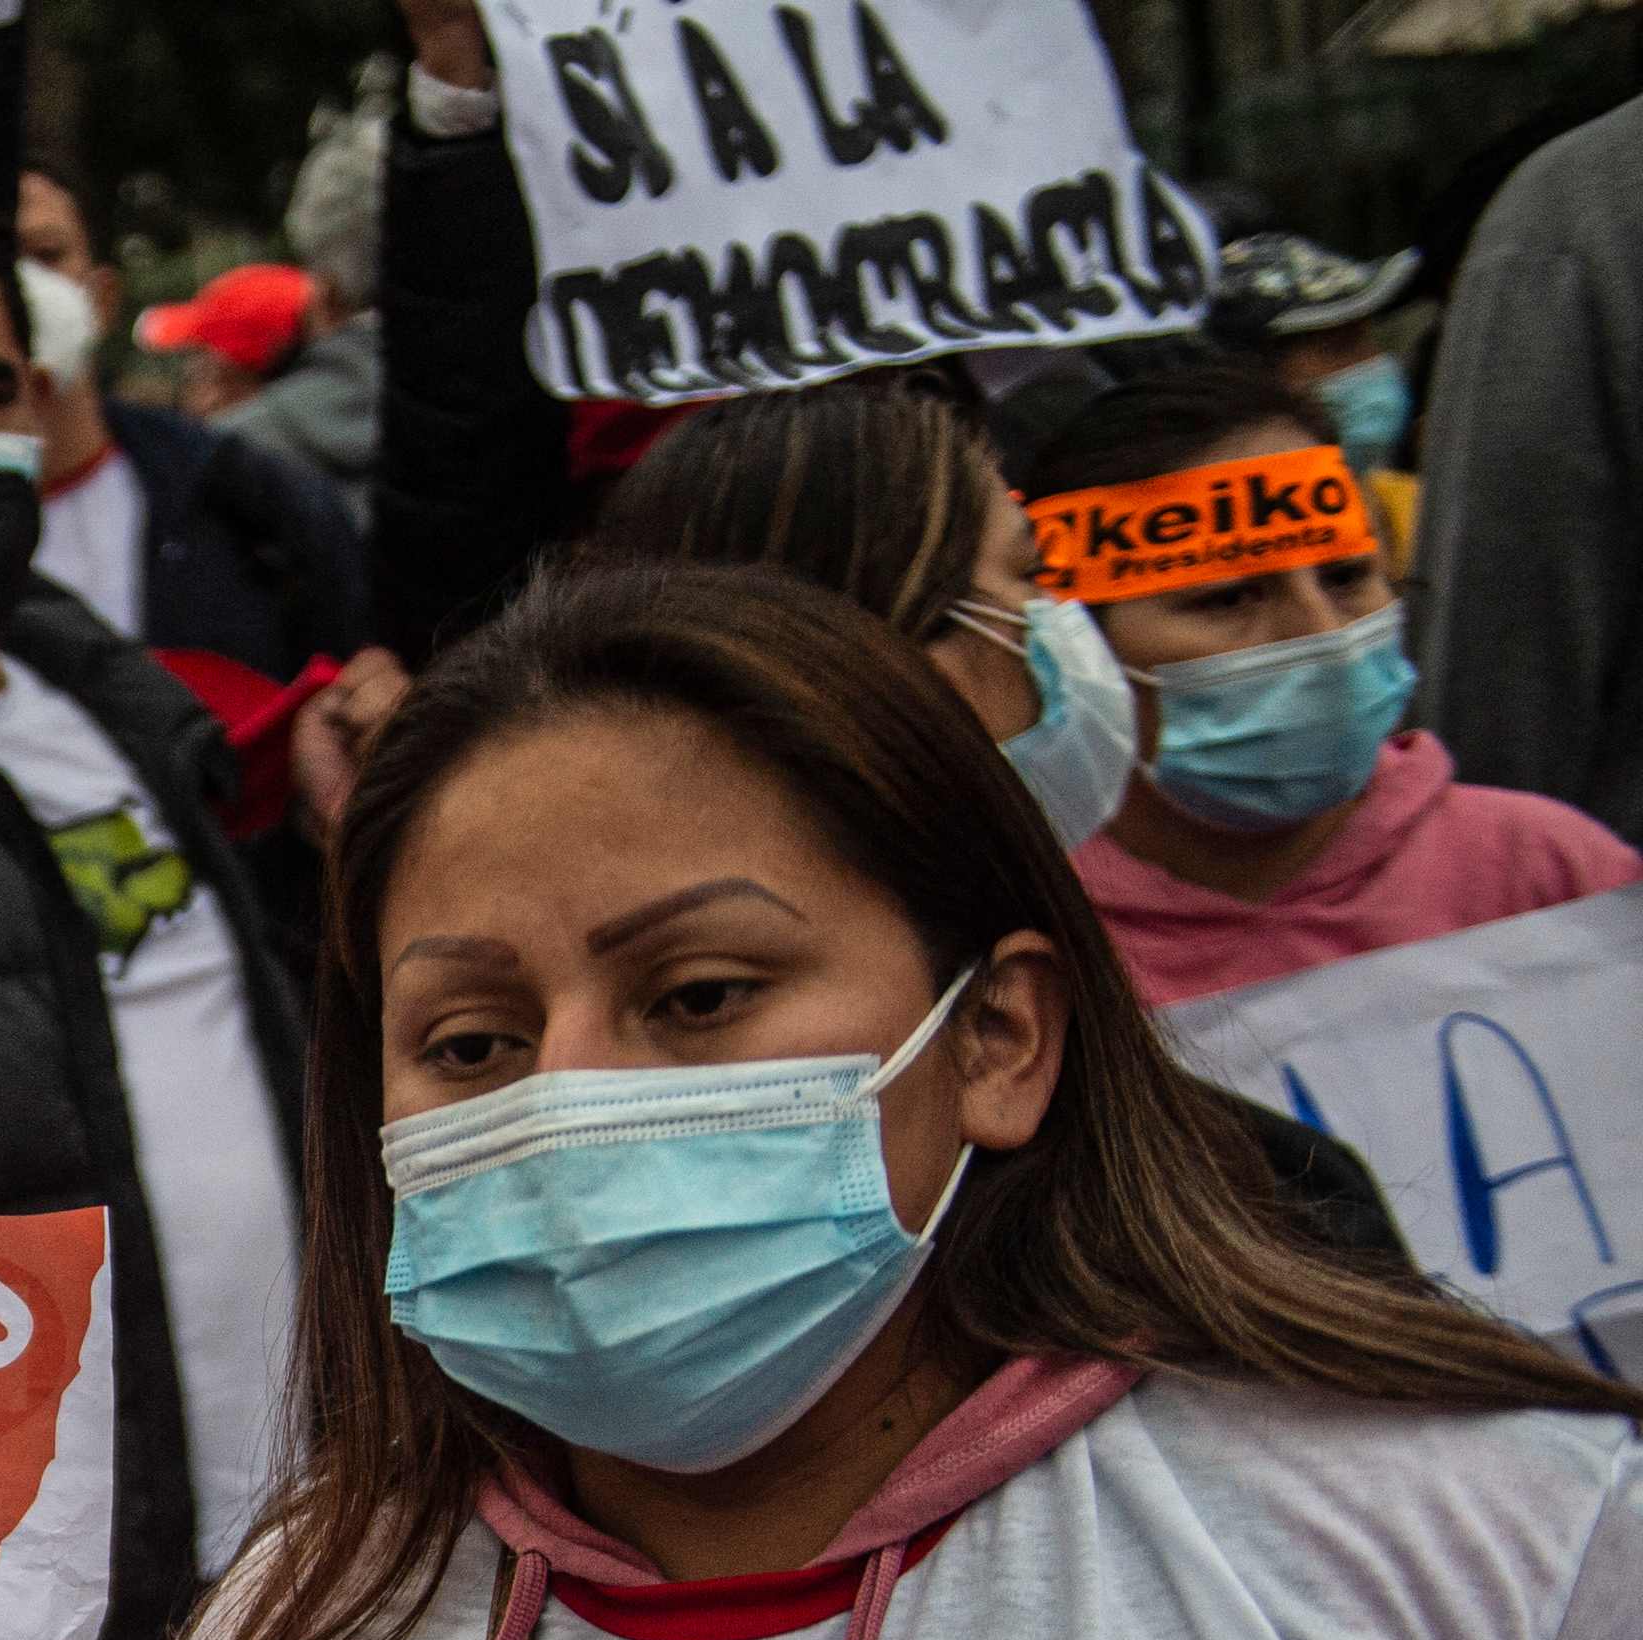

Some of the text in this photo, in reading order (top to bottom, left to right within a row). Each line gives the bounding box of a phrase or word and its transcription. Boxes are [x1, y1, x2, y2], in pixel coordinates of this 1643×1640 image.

[675, 14, 781, 183] A
[773, 0, 950, 166] LA
[1085, 471, 1348, 558] keiko
